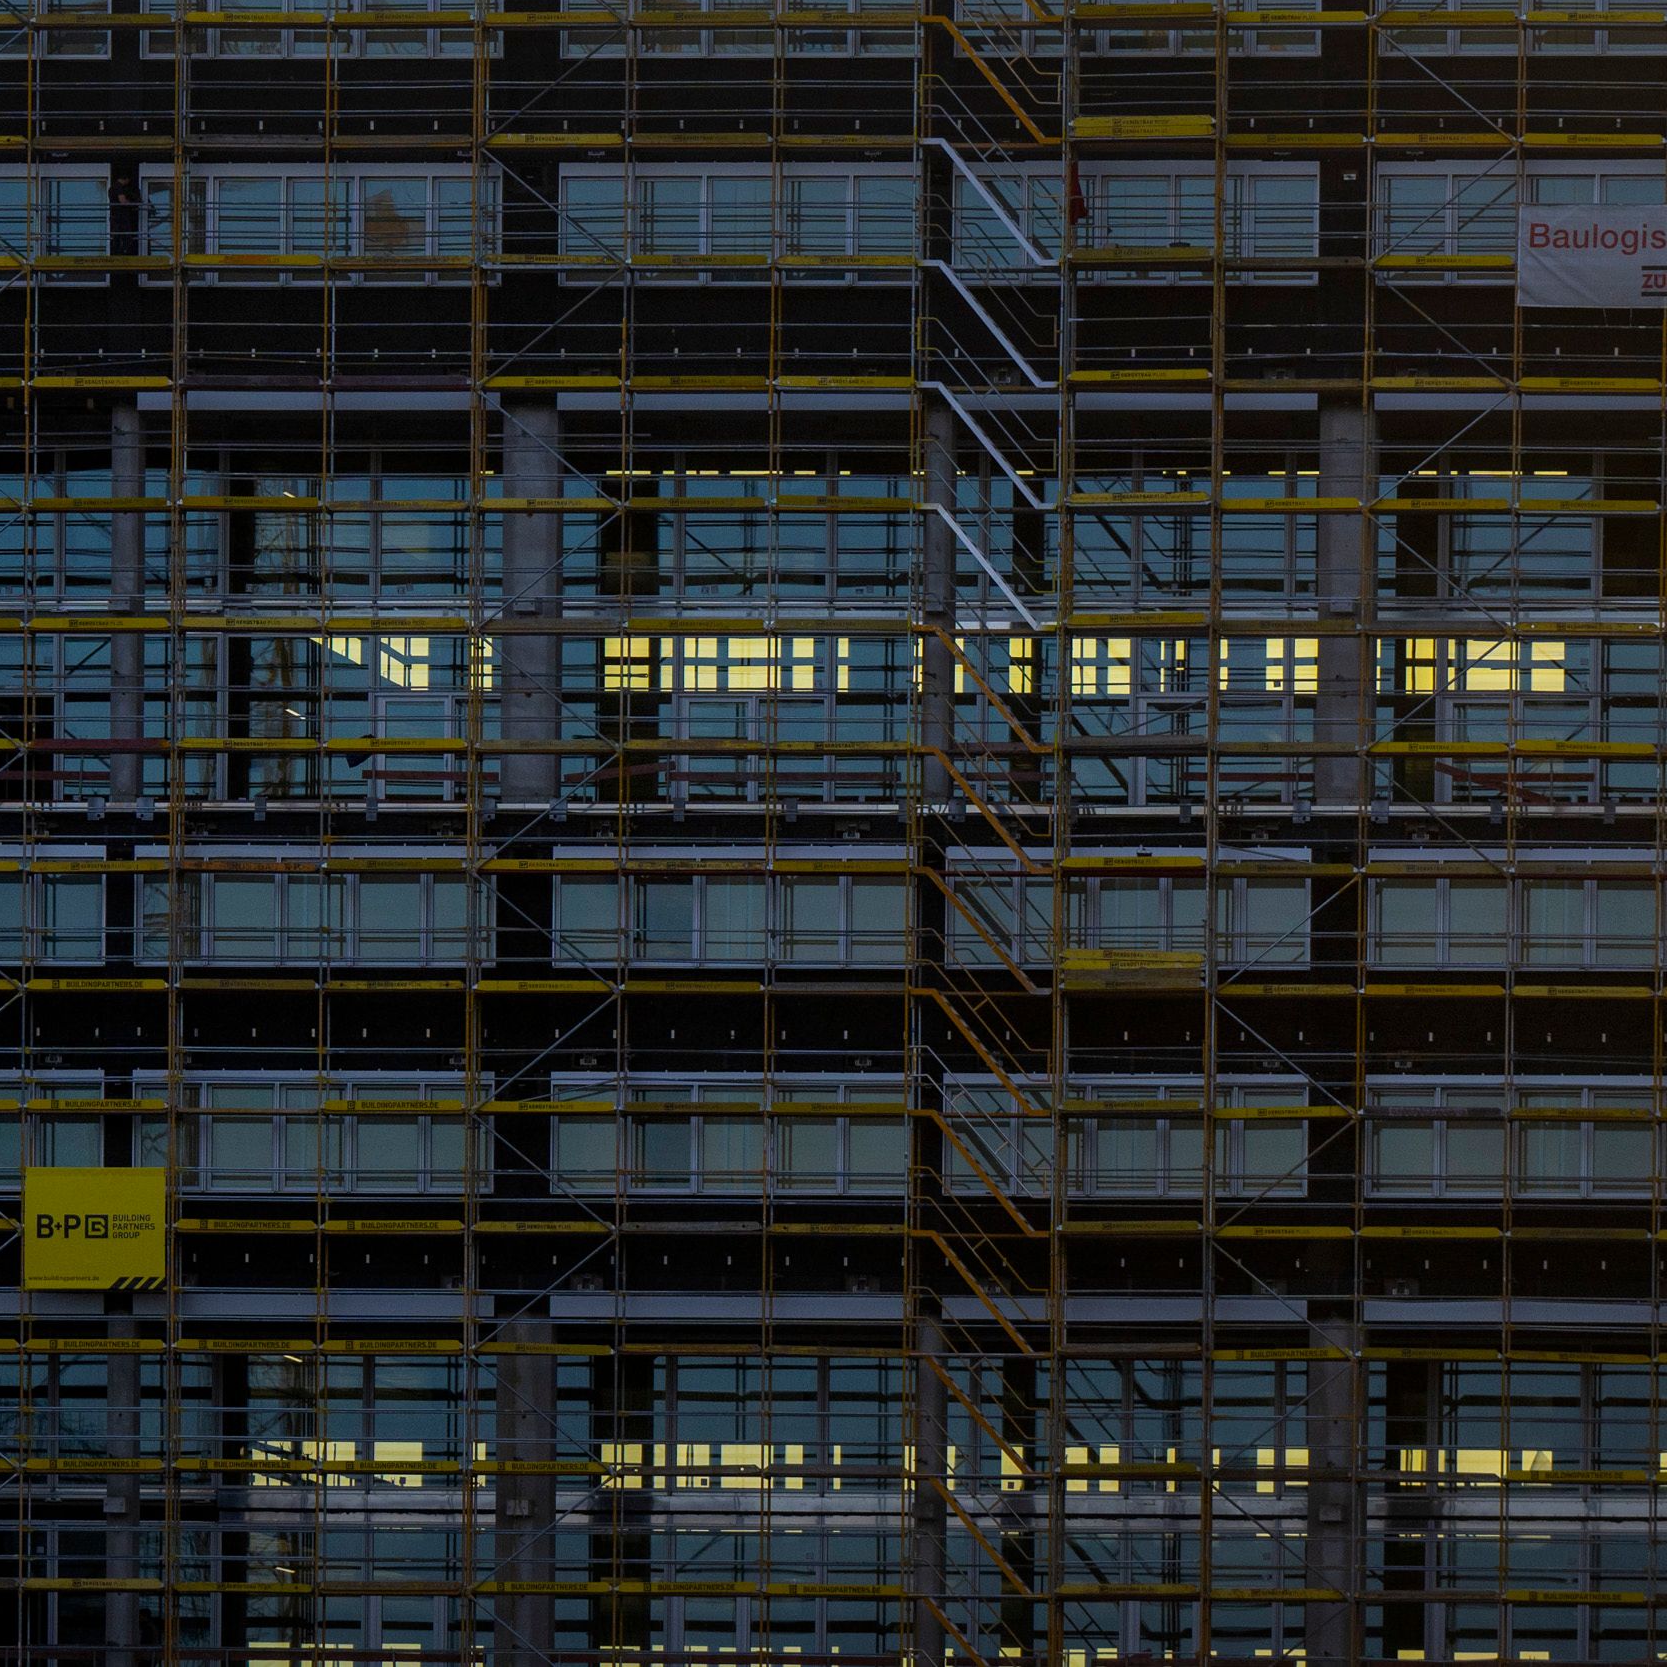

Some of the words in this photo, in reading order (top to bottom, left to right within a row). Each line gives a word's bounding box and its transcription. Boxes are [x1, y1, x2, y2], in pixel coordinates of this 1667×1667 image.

[1529, 222, 1667, 256] Baulogis
[112, 1214, 151, 1222] BUILDING
[112, 1223, 156, 1231] PARTNERS
[112, 1231, 140, 1239] GROUP
